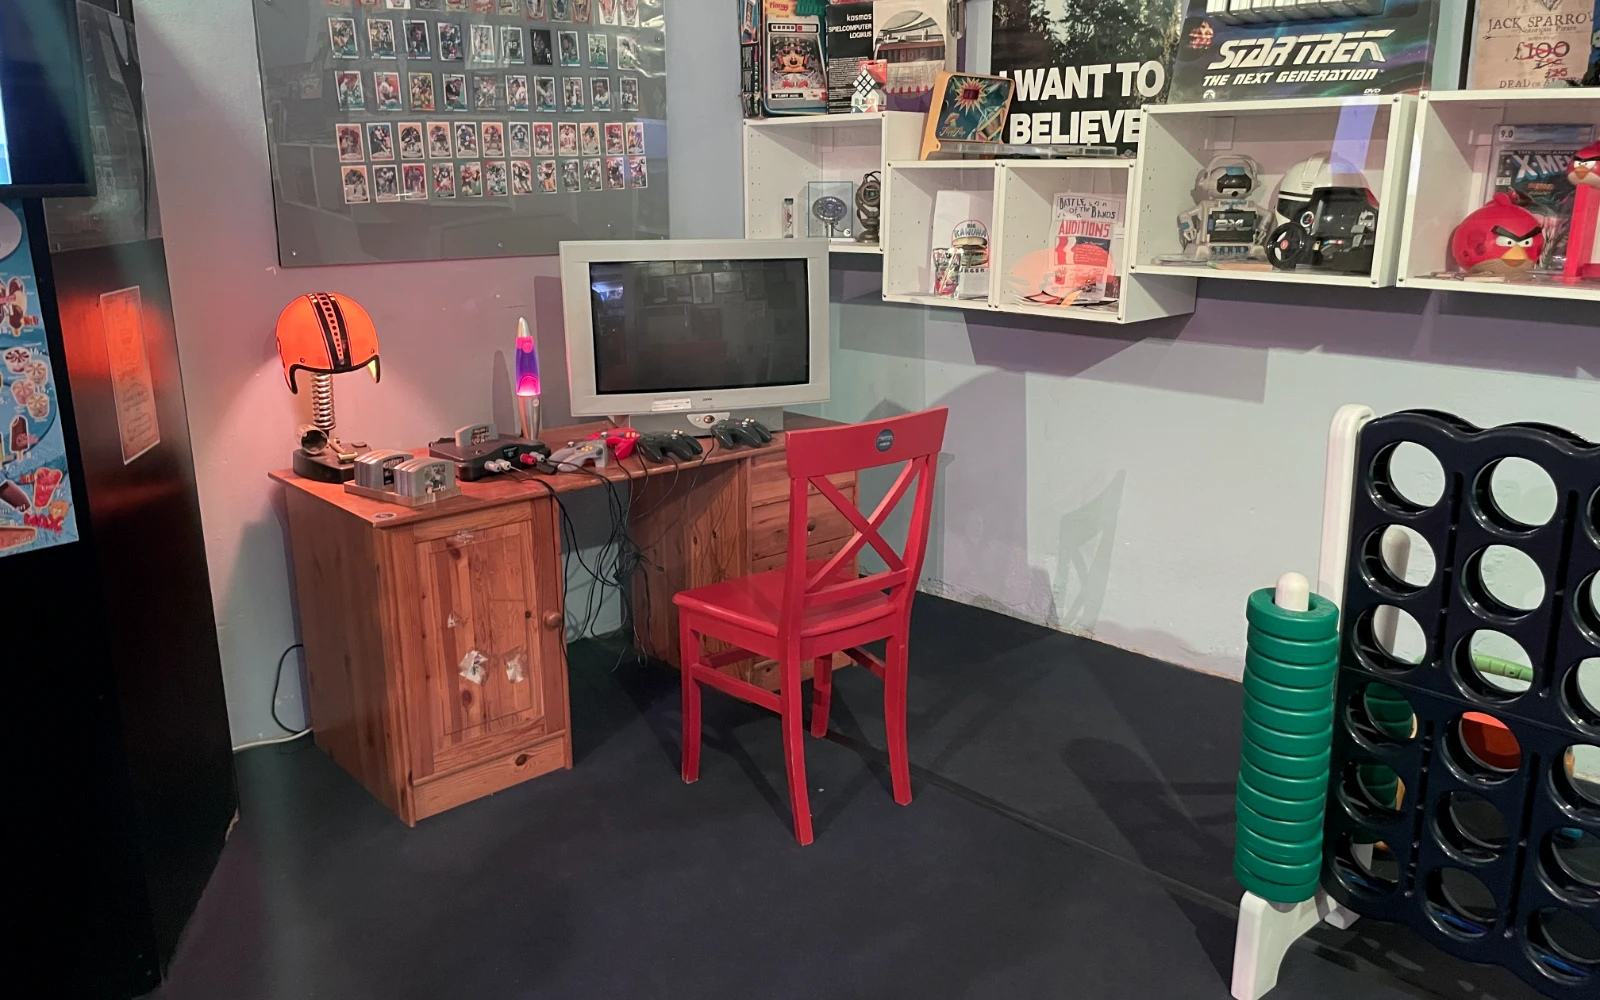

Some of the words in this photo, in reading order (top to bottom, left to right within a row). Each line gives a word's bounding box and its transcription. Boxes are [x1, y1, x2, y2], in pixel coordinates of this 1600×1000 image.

[846, 13, 872, 21] kosmos
[1487, 17, 1520, 34] JACK
[1207, 36, 1298, 70] STAR
[1292, 29, 1395, 65] TREK
[1014, 63, 1112, 102] WANT
[1115, 60, 1165, 97] TO
[1202, 74, 1230, 87] THE
[1232, 71, 1274, 85] NEXT
[1275, 68, 1379, 84] GENERATION
[1499, 79, 1530, 89] DEAD
[1009, 109, 1140, 145] BELIEVE
[1501, 130, 1513, 138] 9.0
[1058, 219, 1111, 238] AUDITIONS
